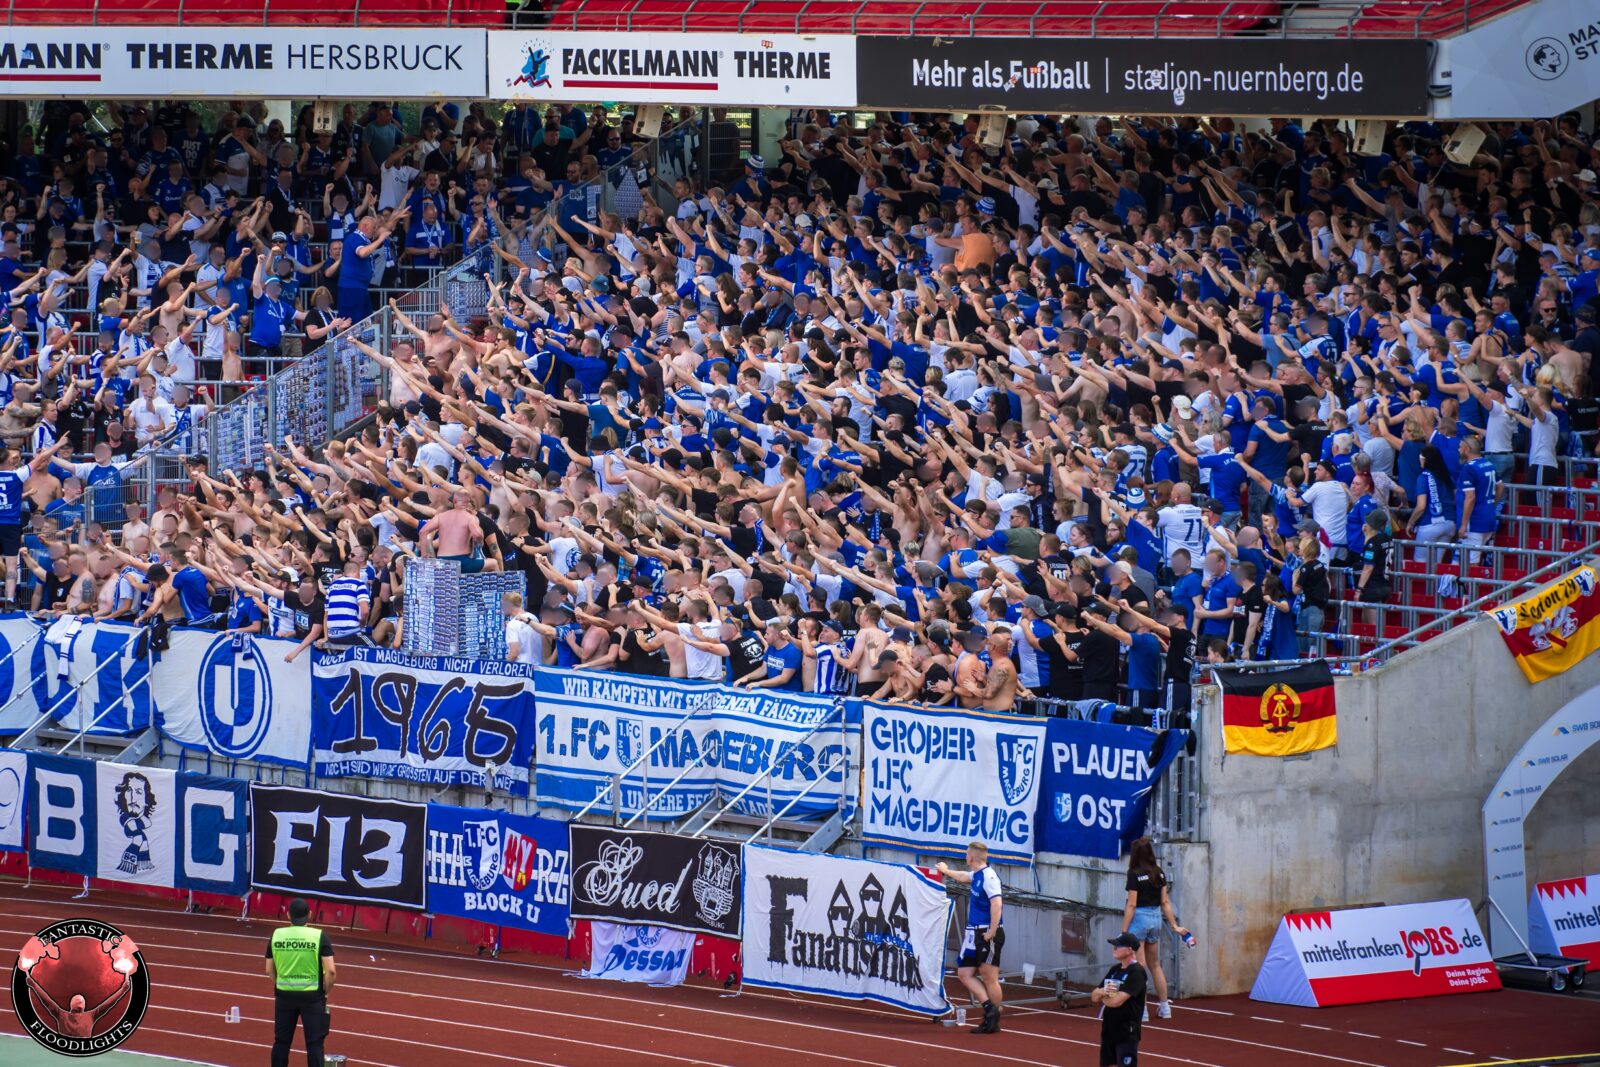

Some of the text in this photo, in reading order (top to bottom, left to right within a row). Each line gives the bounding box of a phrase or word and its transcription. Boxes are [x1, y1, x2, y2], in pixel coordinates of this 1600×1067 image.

[1569, 21, 1600, 46] MA
[127, 43, 273, 69] THERME
[288, 44, 463, 71] HERSBRUCK
[562, 48, 831, 79] FACKELMANN THERME
[1575, 40, 1598, 60] ST
[912, 58, 1364, 100] Mehr als Fußball stadion-nuernberg.de
[182, 139, 201, 151] JUST
[185, 151, 198, 160] DO
[353, 645, 370, 661] IST
[375, 648, 438, 670] MAGDEBURG
[443, 657, 476, 673] NICHT
[480, 660, 534, 678] VERLOREN
[562, 678, 591, 698] WIR
[592, 678, 657, 708] KÄMPFEN
[659, 689, 684, 710] MIT
[760, 698, 828, 725] FÄUSTEN
[539, 713, 610, 761] 1.FC
[1572, 722, 1589, 732] SWB
[1001, 741, 1033, 765] 1.FC
[1051, 742, 1155, 781] PLAUEN
[433, 768, 456, 785] AUF
[461, 771, 486, 787] DER
[871, 756, 913, 794] 1.FC
[35, 767, 239, 882] B G
[869, 790, 1029, 845] MAGDEBURG
[1076, 794, 1126, 831] OST
[465, 825, 498, 847] 1.FC
[463, 892, 541, 924] BLOCK U
[1553, 904, 1600, 931] mittel
[287, 941, 317, 949] POWER
[1445, 969, 1466, 978] Deine
[1449, 978, 1470, 987] Deine
